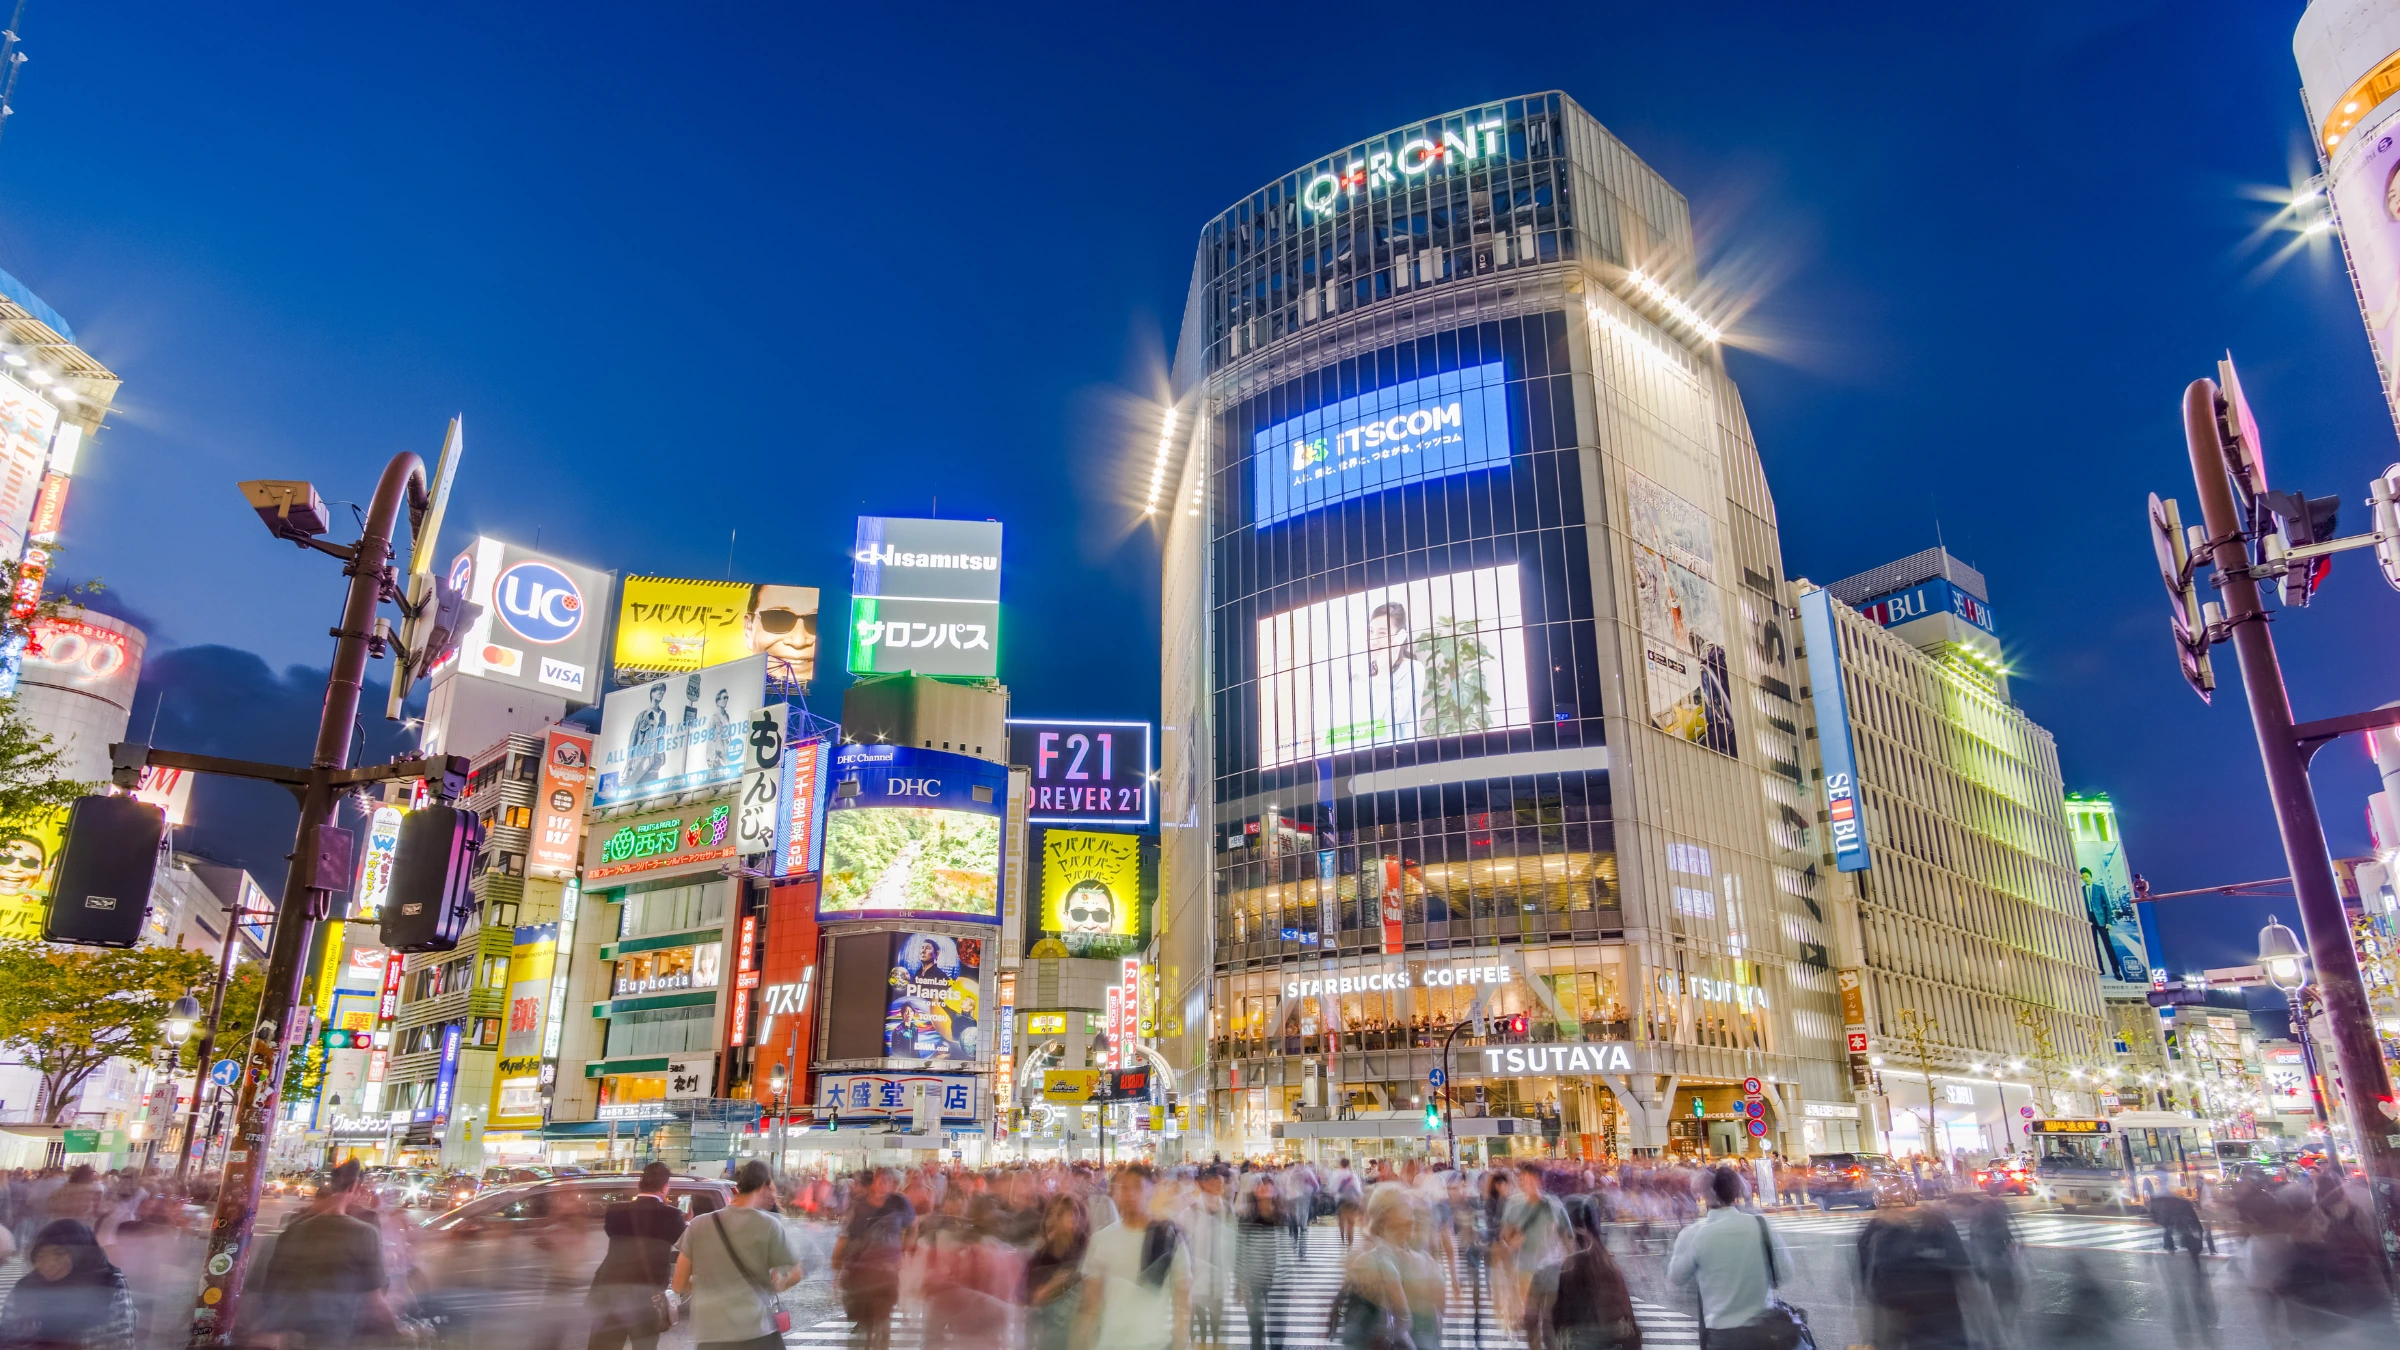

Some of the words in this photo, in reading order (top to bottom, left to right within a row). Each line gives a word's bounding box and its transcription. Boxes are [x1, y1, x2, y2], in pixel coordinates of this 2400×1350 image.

[1304, 119, 1502, 216] QFRONT
[856, 543, 998, 571] Hisamitsu
[630, 602, 740, 627] ヤバババーン
[44, 617, 126, 647] SHIBUYA
[857, 619, 989, 650] サロンパス
[545, 664, 582, 685] VISA
[605, 749, 625, 765] ALL
[659, 734, 686, 754] BEST
[688, 720, 750, 747] 1998-2018
[1038, 732, 1112, 781] F21
[837, 754, 857, 765] DHC
[857, 752, 893, 763] Channel
[737, 710, 782, 848] もんじゃ
[887, 778, 941, 797] DHC
[787, 750, 811, 866] 三千里薬品
[1118, 788, 1141, 811] 21
[1827, 773, 1859, 854] SEIBU
[635, 829, 679, 858] 西村
[1049, 836, 1133, 861] ヤバババーン
[1057, 855, 1124, 875] ヤバババーン
[1004, 862, 1019, 917] neon
[618, 974, 688, 995] Euphoria
[906, 984, 961, 1002] Planets
[915, 975, 948, 986] teamLab
[1287, 971, 1410, 998] STARBUCKS
[1423, 966, 1511, 988] COFFEE
[1125, 967, 1137, 1026] カラオケ
[346, 1012, 372, 1032] 薬
[511, 996, 540, 1033] 薬
[918, 1013, 948, 1022] TOYOSU
[1141, 1021, 1152, 1031] 4F
[446, 1032, 459, 1062] MIZUHO
[1850, 1035, 1865, 1049] 本
[1485, 1045, 1631, 1073] TSUTAYA
[826, 1081, 968, 1110] 大盛堂店
